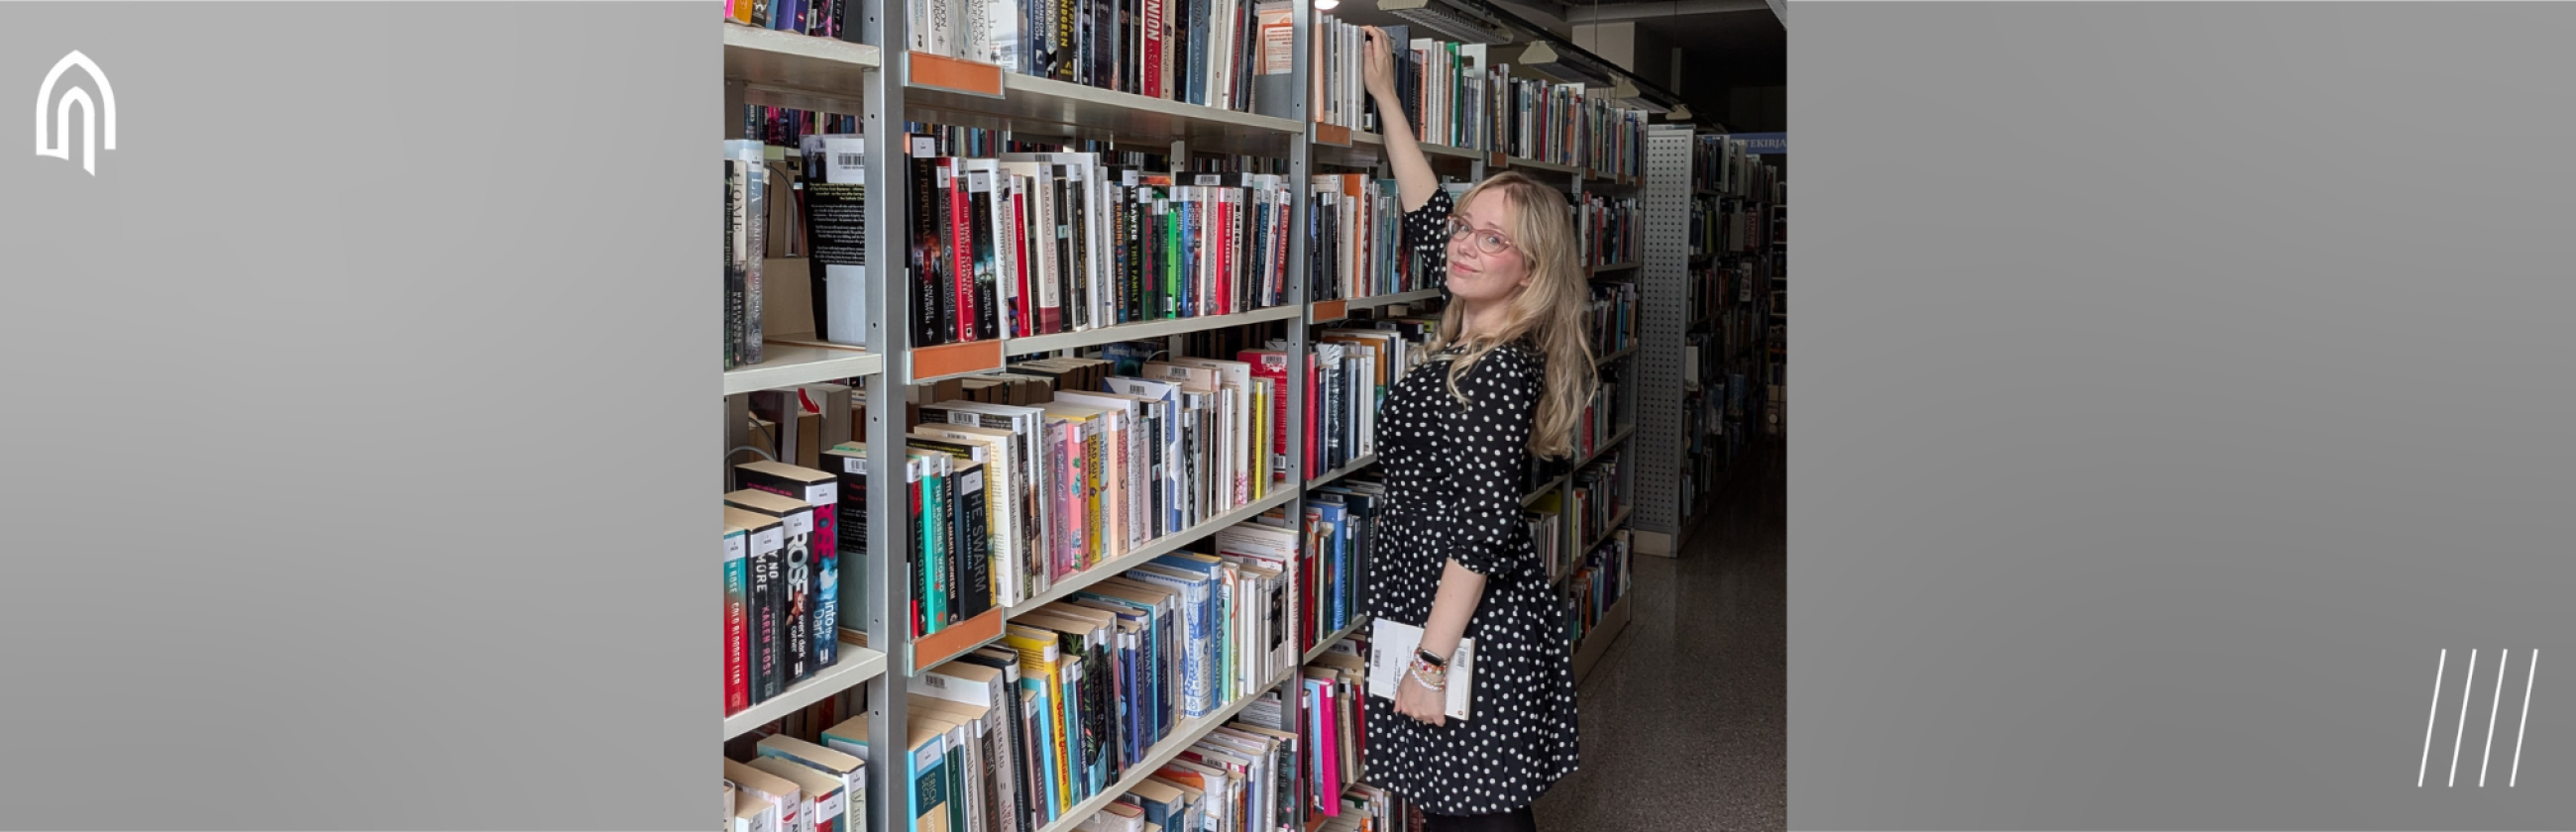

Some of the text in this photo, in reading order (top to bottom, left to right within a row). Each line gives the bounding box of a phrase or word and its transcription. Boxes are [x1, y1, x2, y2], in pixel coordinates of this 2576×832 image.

[1043, 185, 1052, 236] SARAMAGO
[729, 570, 738, 593] ROSE
[768, 562, 779, 578] NO
[787, 534, 808, 601] ROSE
[972, 526, 987, 593] SWARM
[813, 608, 825, 640] Dark
[823, 601, 836, 625] Into
[762, 605, 772, 677] KAREN ROSE
[797, 614, 806, 659] every dark
[996, 716, 1005, 769] SEIERSTAD
[928, 772, 937, 805] ERICH
